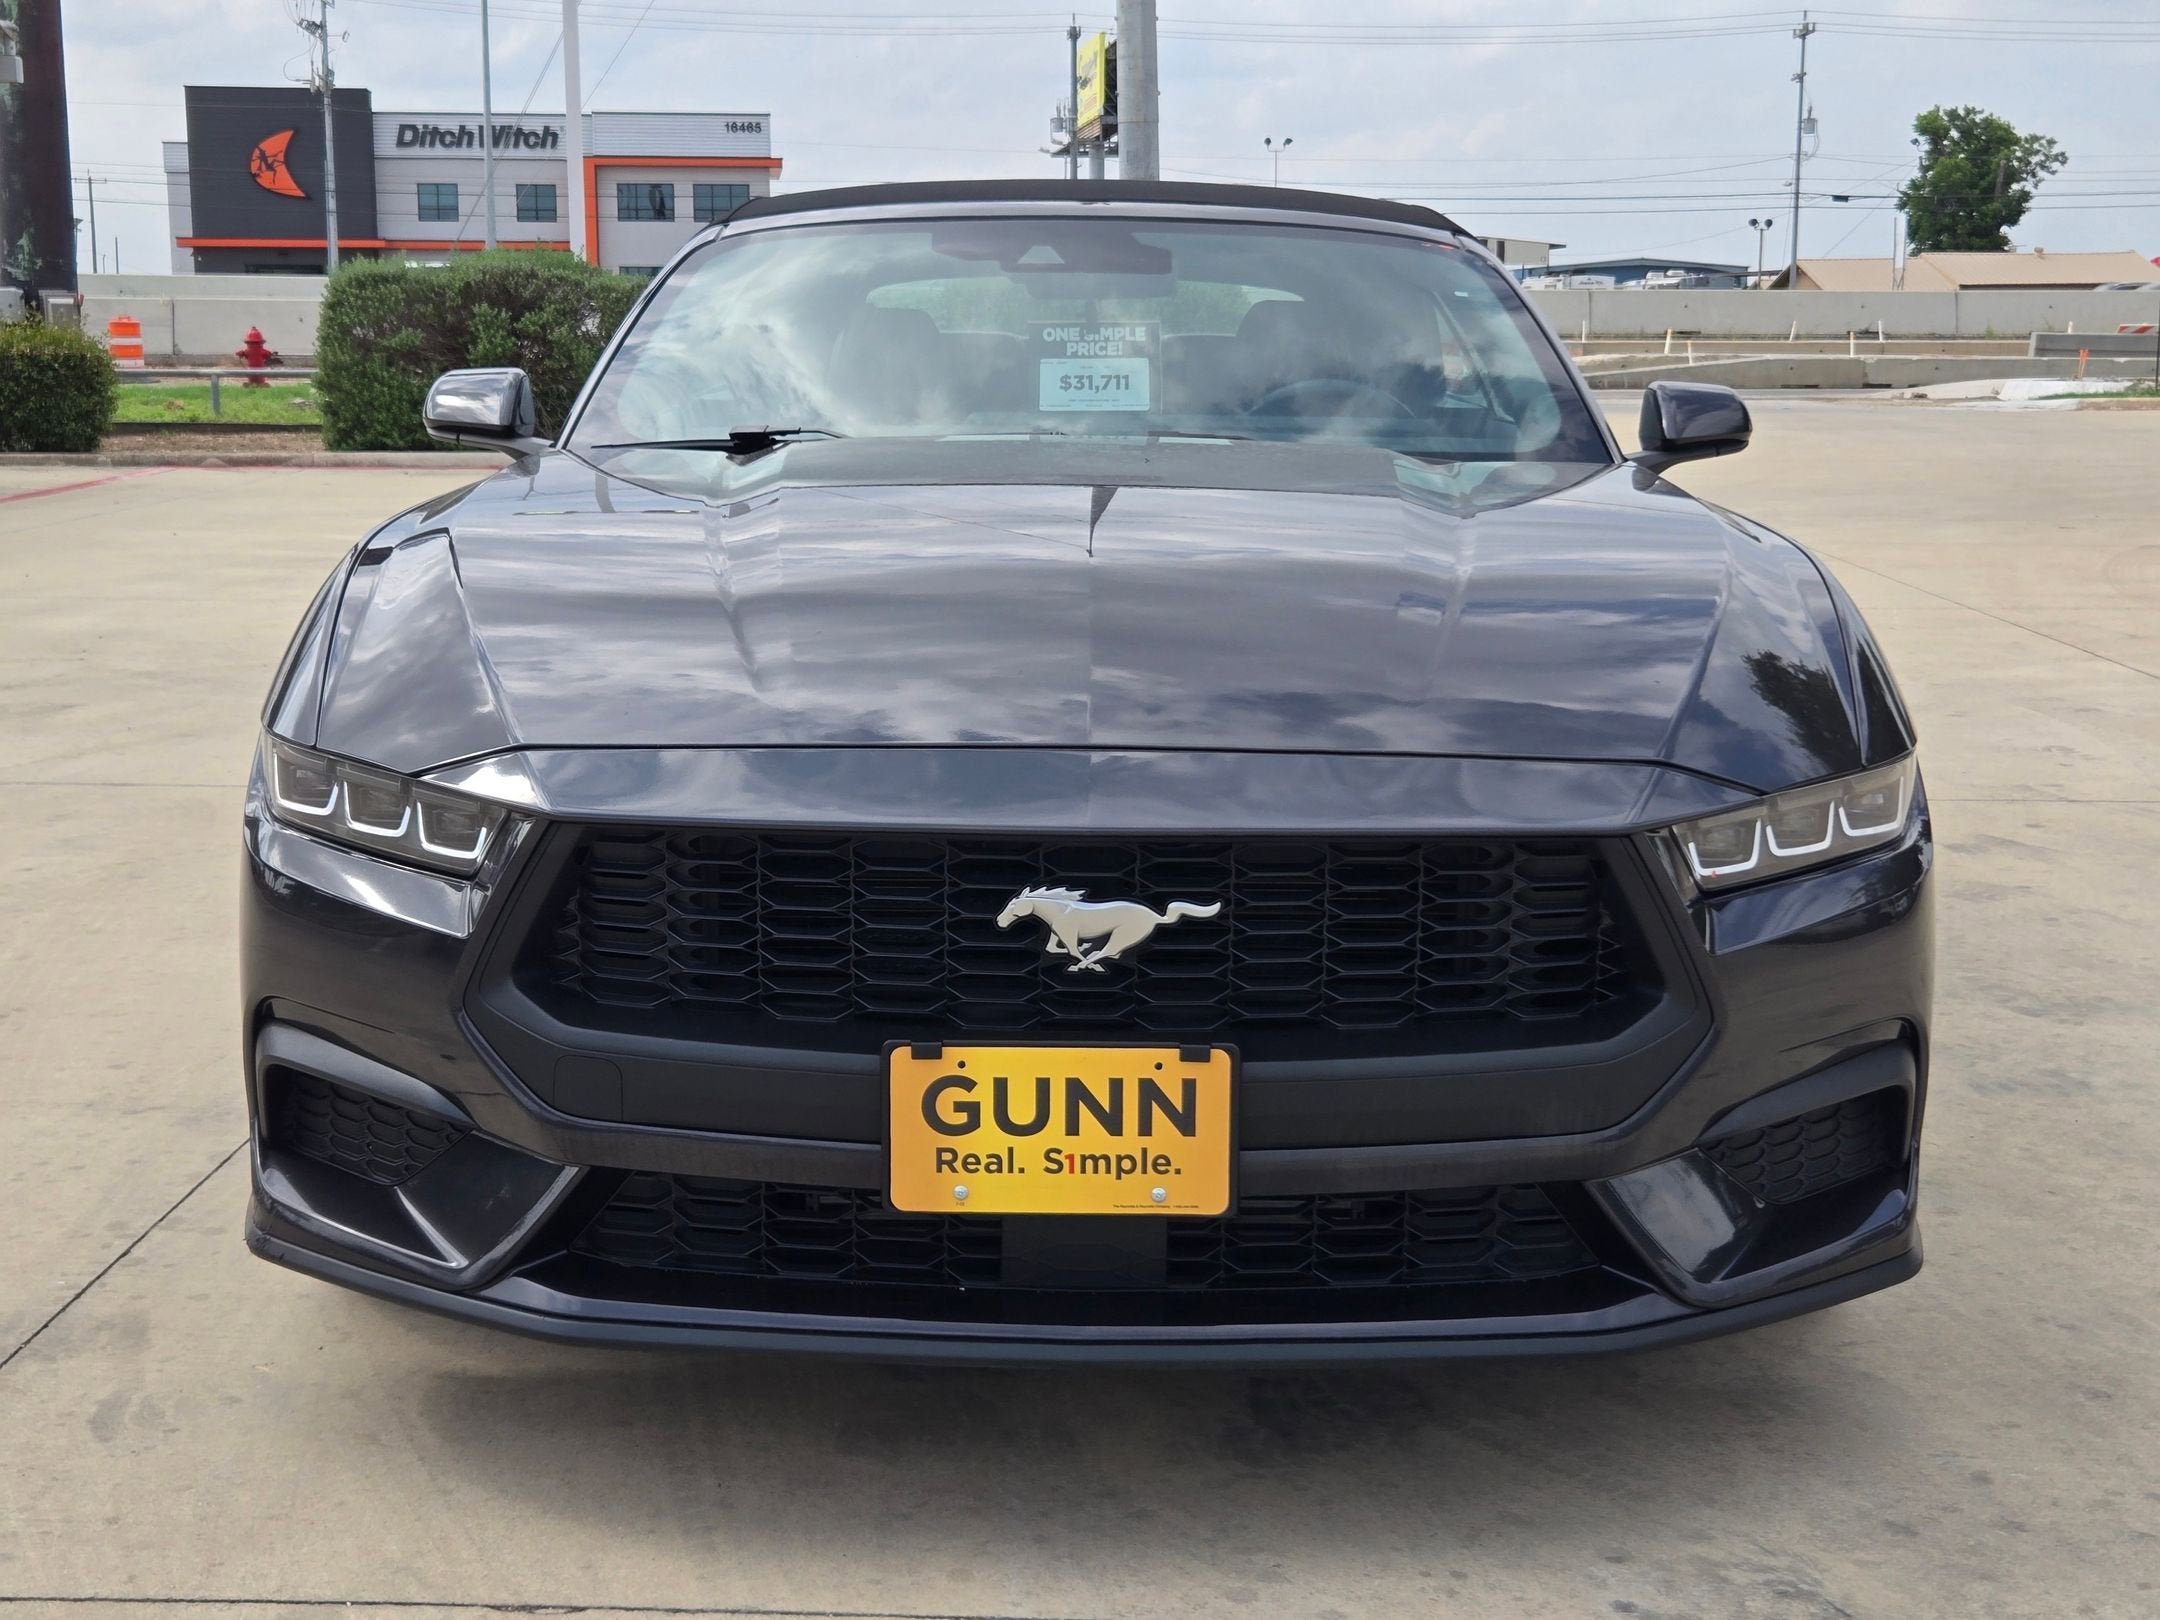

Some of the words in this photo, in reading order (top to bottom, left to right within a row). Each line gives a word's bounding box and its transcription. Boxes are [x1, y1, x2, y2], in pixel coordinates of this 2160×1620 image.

[396, 124, 475, 148] Ditch
[478, 125, 559, 149] Witch
[1042, 327, 1080, 342] ONE
[1066, 341, 1123, 356] PRICE!
[1059, 374, 1130, 393] $31,711
[921, 1074, 1197, 1137] GUNN
[935, 1146, 1025, 1174] Real.
[1043, 1147, 1182, 1180] S1mple.
